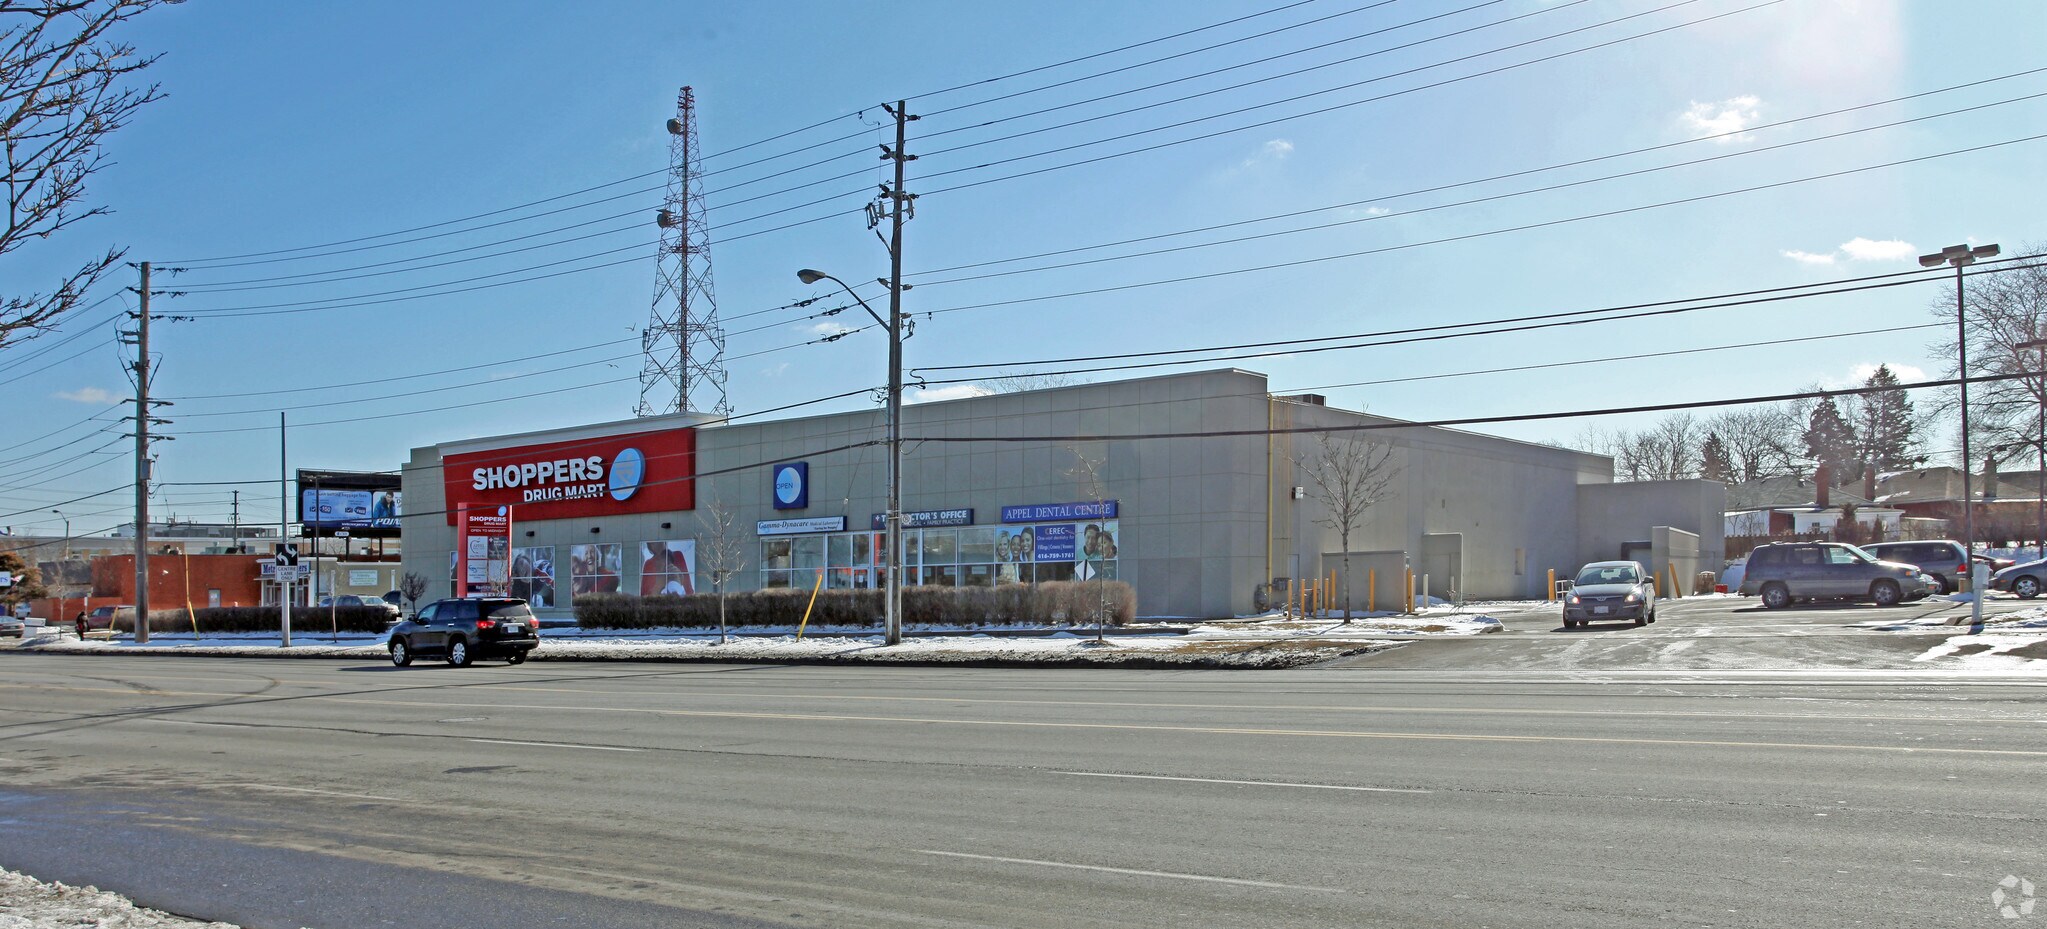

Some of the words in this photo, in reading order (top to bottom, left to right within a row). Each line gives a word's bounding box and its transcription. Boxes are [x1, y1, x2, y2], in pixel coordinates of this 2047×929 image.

[472, 456, 604, 491] SHOPPERS
[524, 488, 562, 502] DRUG
[564, 483, 606, 500] MART
[940, 510, 967, 519] OFFICE
[1006, 509, 1032, 519] APPEL
[1036, 506, 1071, 518] DENTAL
[1074, 503, 1111, 515] CENTRE
[759, 520, 809, 530] Gamma-Dynacare
[943, 517, 964, 525] PRACTICE
